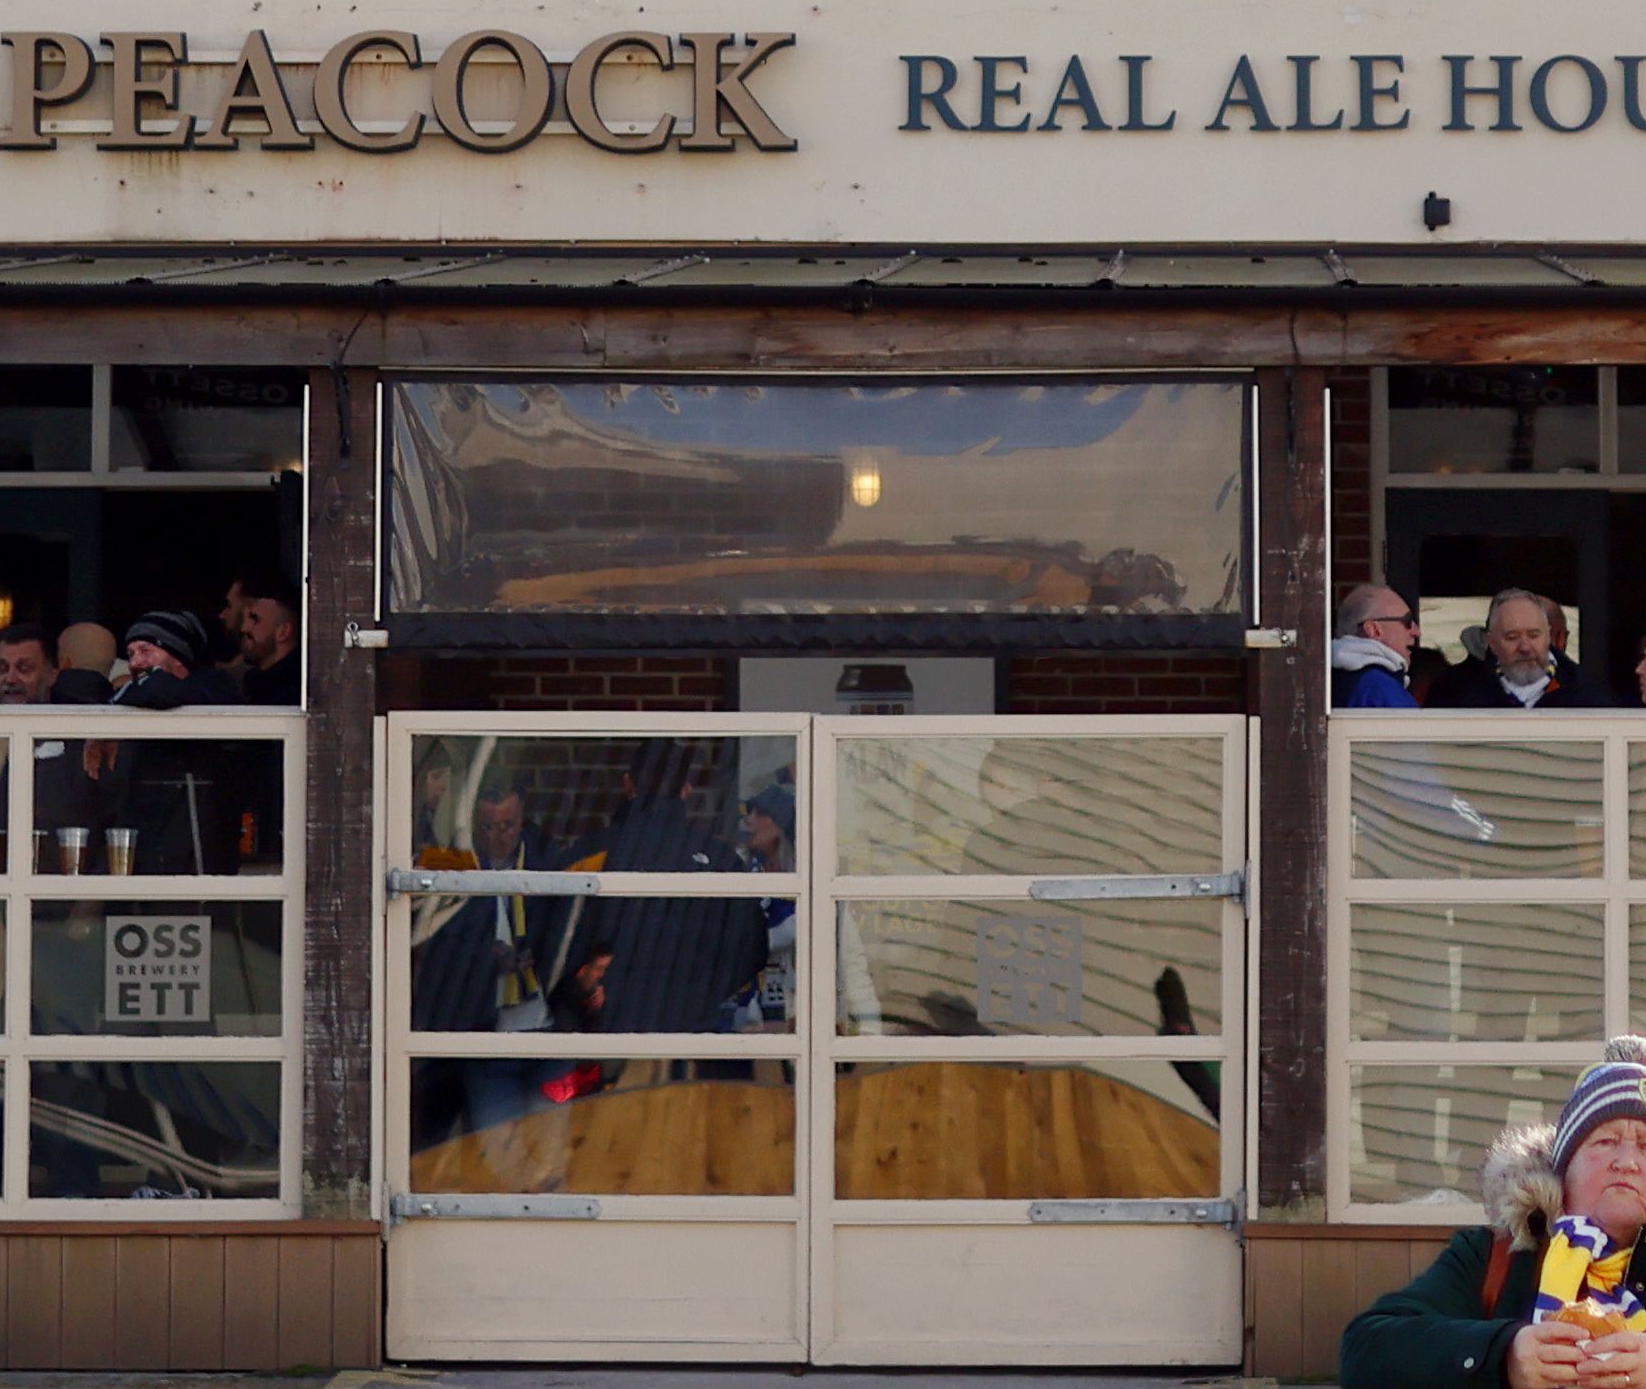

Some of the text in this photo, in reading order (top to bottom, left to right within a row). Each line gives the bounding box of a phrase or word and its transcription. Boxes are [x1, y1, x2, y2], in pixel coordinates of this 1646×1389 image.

[897, 54, 1178, 133] REAL
[1203, 54, 1412, 133] ALE
[113, 923, 203, 959] OSS
[115, 964, 201, 976] BREWERY
[118, 982, 201, 1016] ETT
